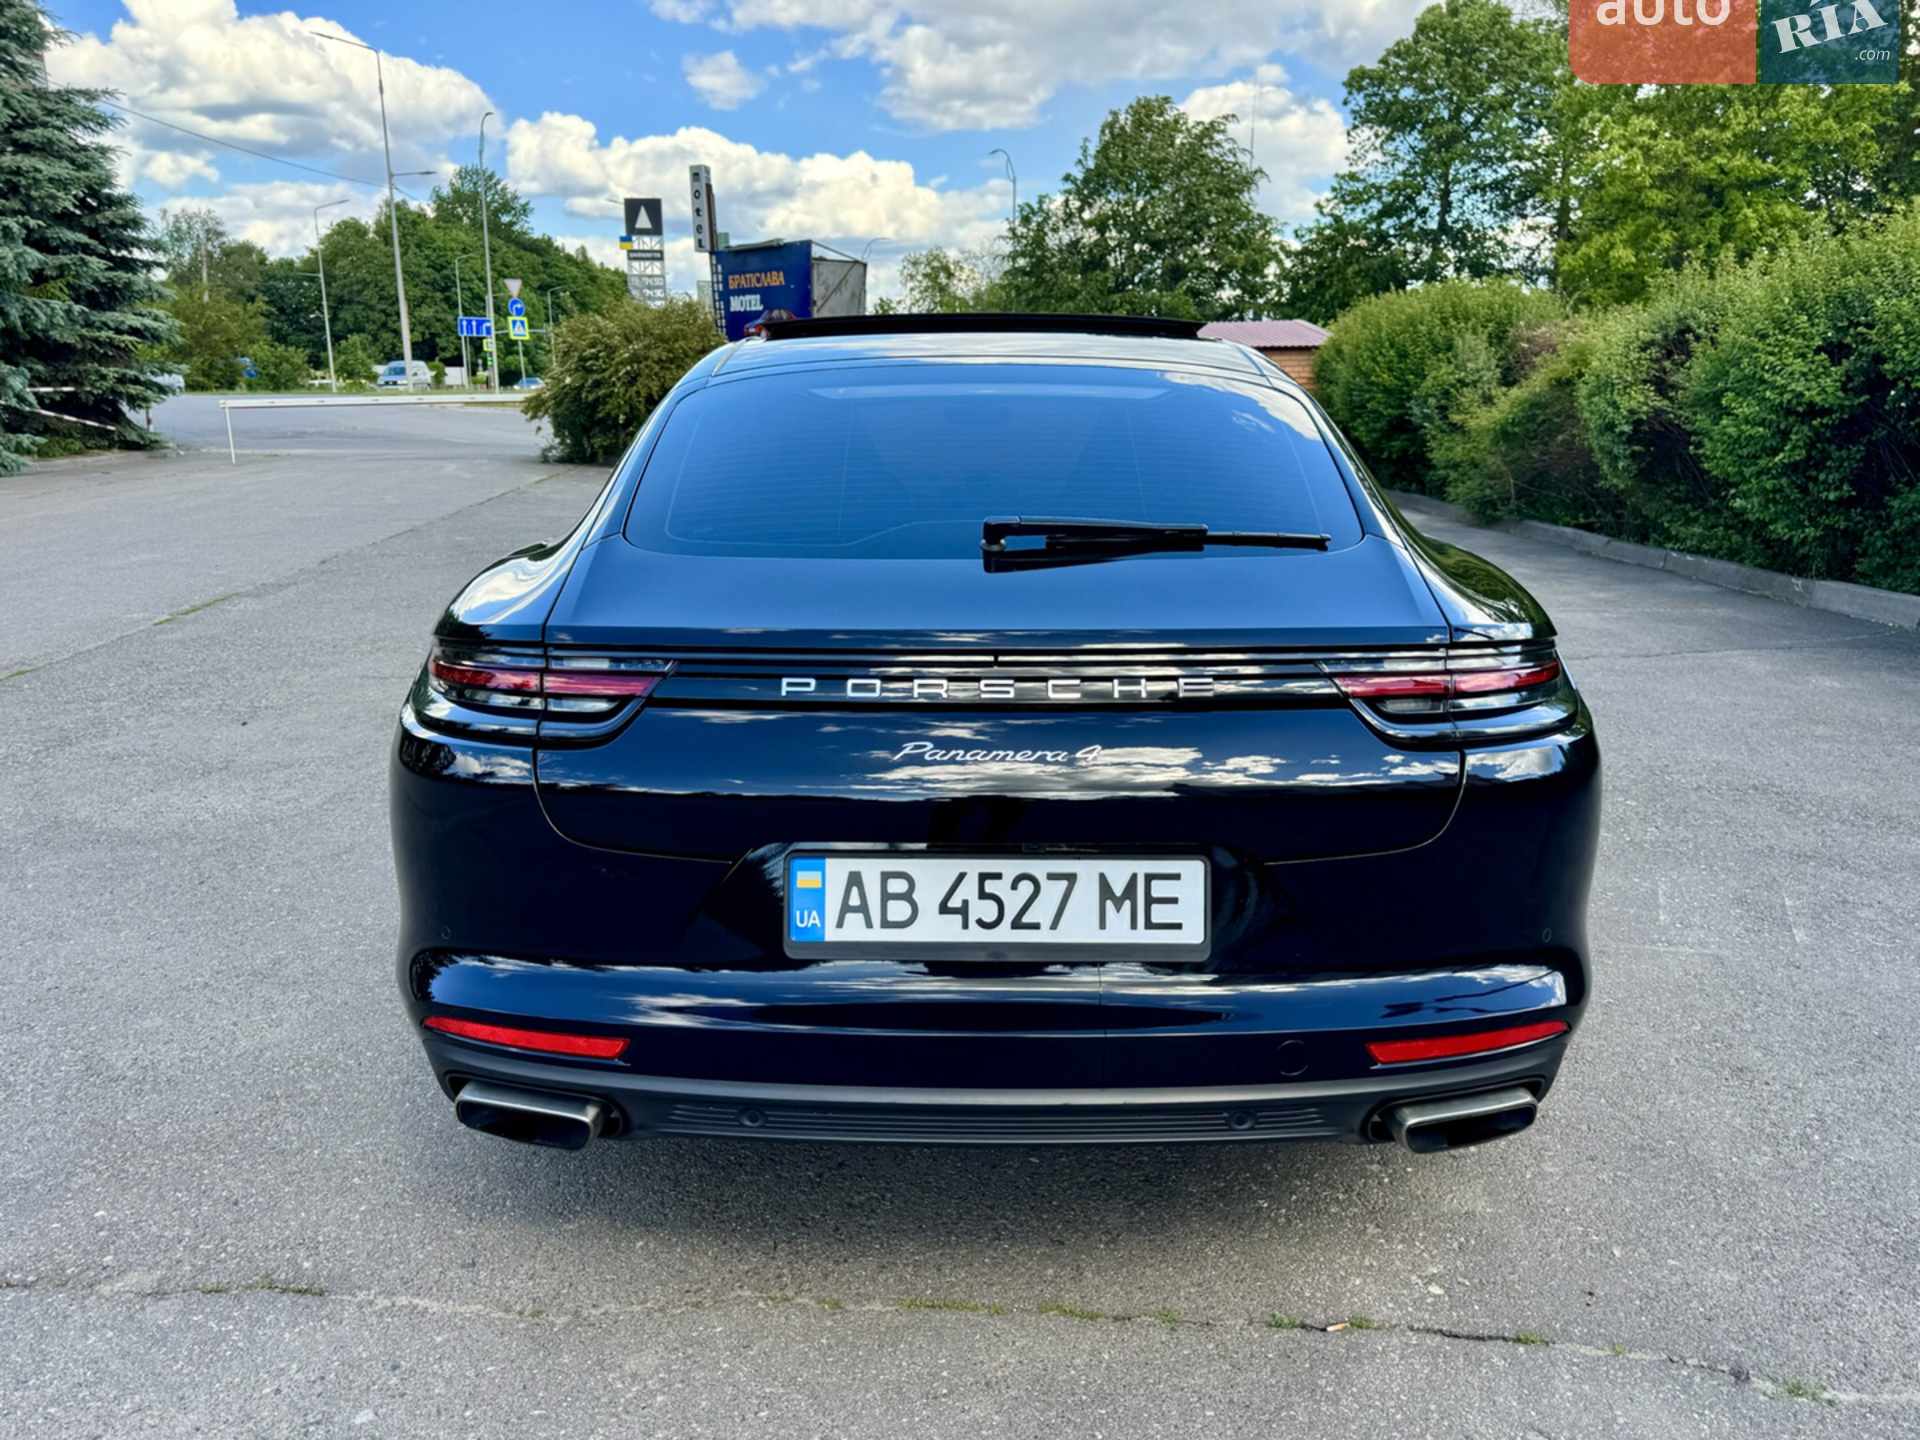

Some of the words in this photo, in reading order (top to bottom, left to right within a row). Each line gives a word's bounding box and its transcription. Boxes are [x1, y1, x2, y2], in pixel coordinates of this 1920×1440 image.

[728, 271, 785, 289] БРАТІСЛАВА
[729, 294, 764, 312] MOTEL
[780, 677, 1215, 699] PORSCHE
[892, 741, 1069, 762] Panamera
[1074, 744, 1102, 762] 4
[835, 870, 919, 930] AB
[938, 871, 1078, 931] 4527
[1098, 872, 1183, 931] ME
[795, 910, 821, 928] UA
